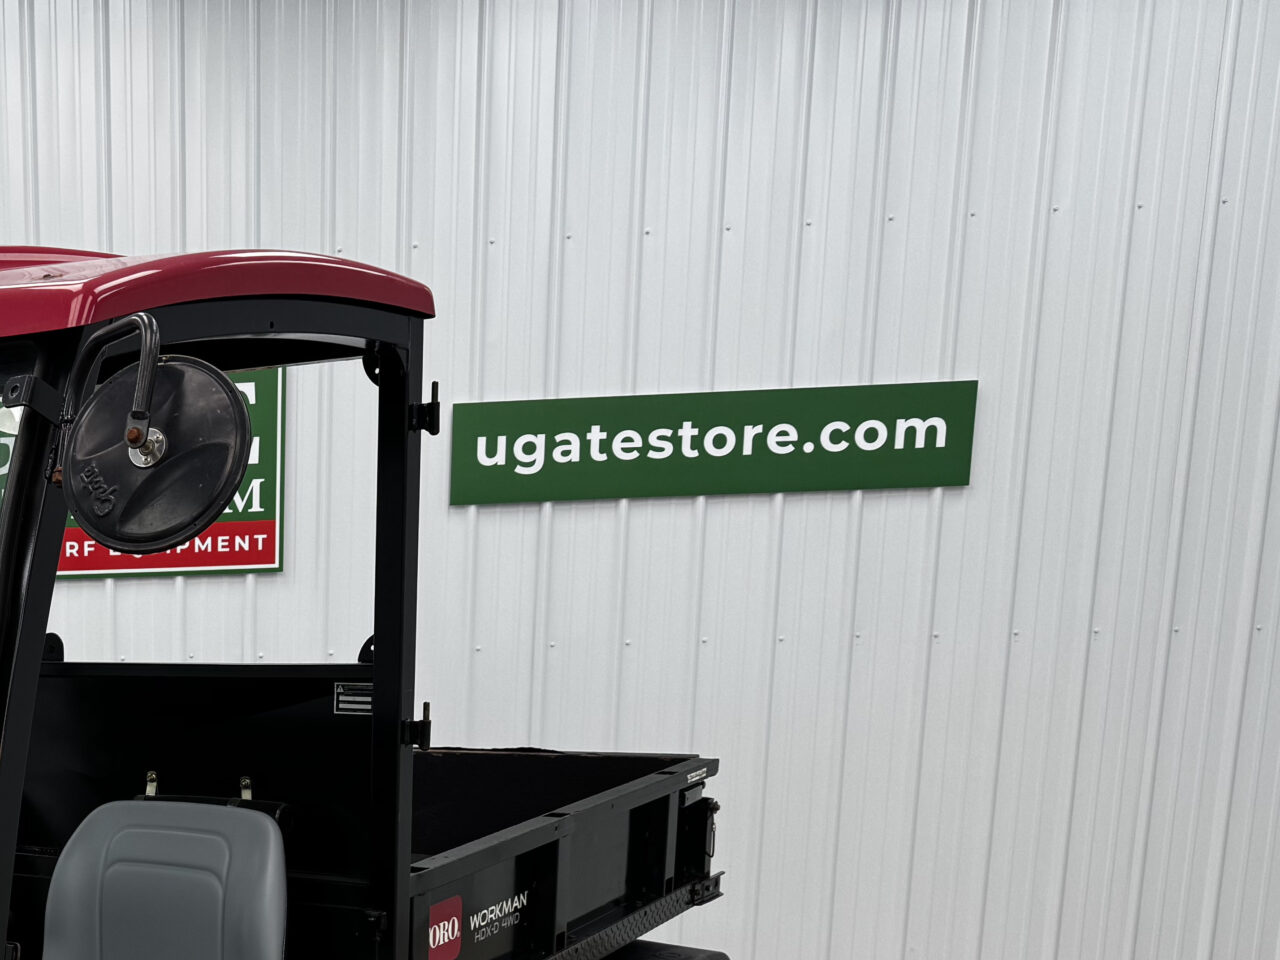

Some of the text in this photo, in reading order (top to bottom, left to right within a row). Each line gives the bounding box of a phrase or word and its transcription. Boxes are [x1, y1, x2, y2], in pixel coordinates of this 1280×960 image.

[476, 415, 947, 475] ugatestore.com
[65, 541, 96, 557] RF
[470, 891, 528, 930] WORKMAN
[502, 912, 520, 929] 4WD
[429, 917, 458, 949] ORO
